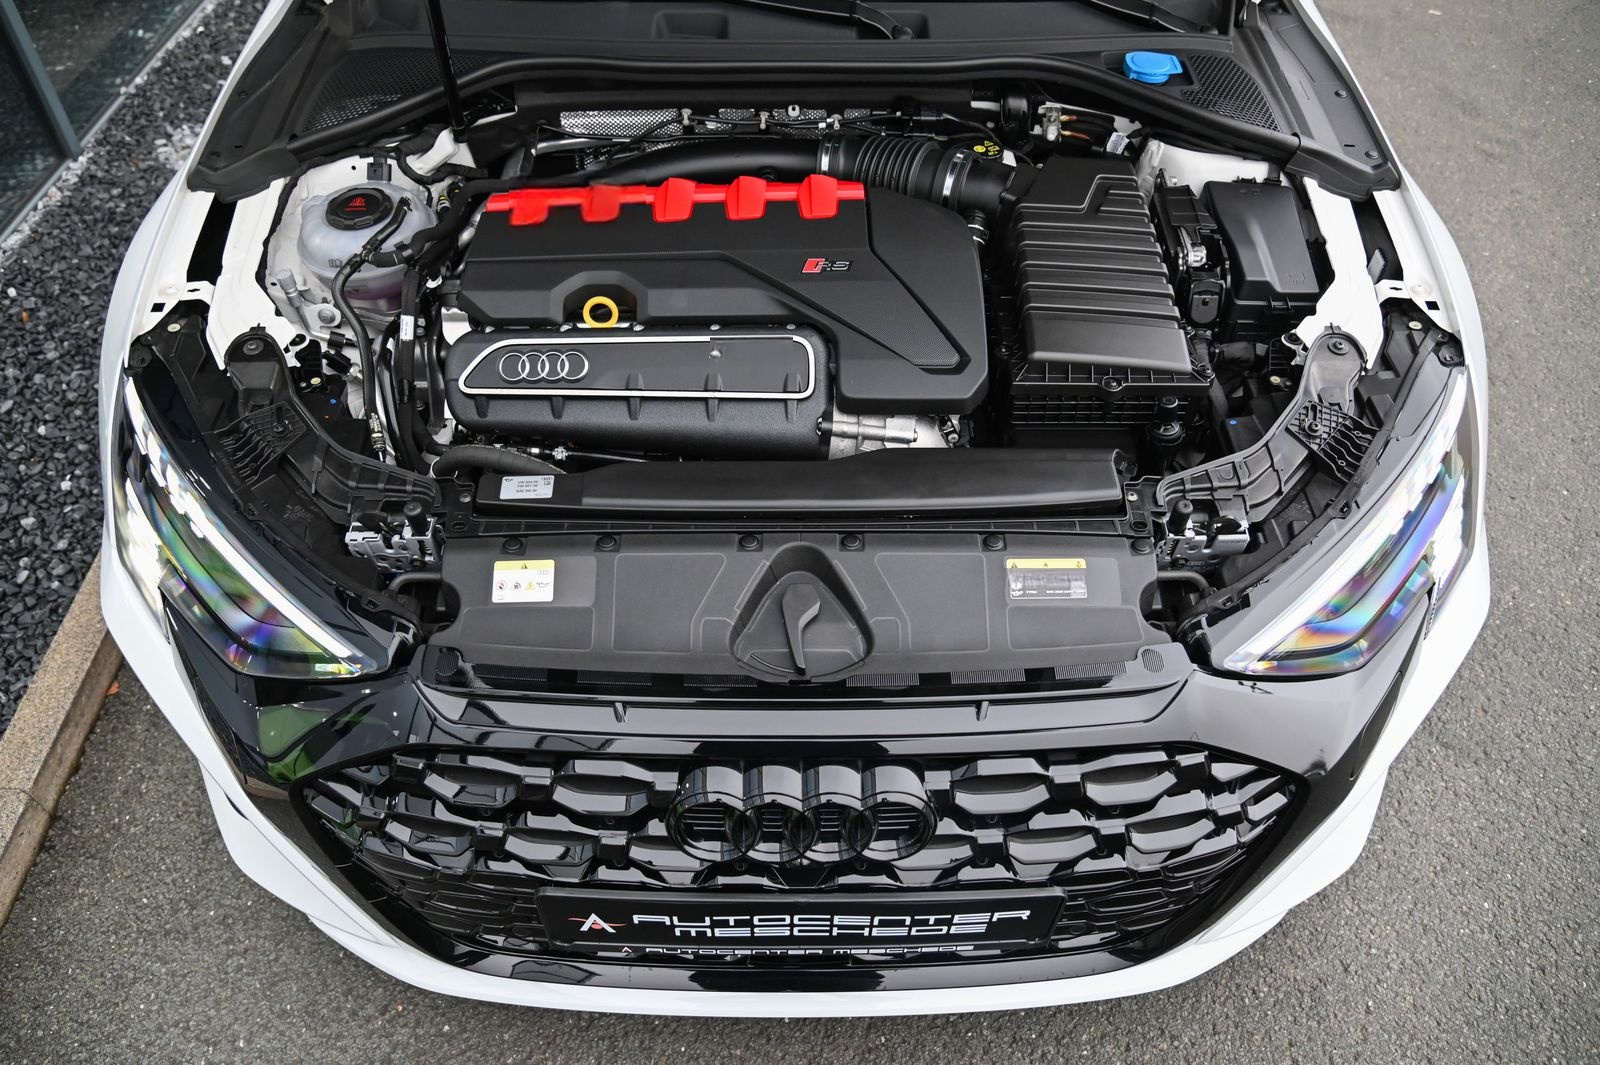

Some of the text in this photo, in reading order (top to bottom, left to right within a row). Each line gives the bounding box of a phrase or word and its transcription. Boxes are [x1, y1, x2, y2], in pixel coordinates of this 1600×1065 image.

[632, 910, 1031, 927] AUTOCENTER
[674, 923, 988, 937] MESCHEDE
[645, 947, 824, 955] AUTOCENTER
